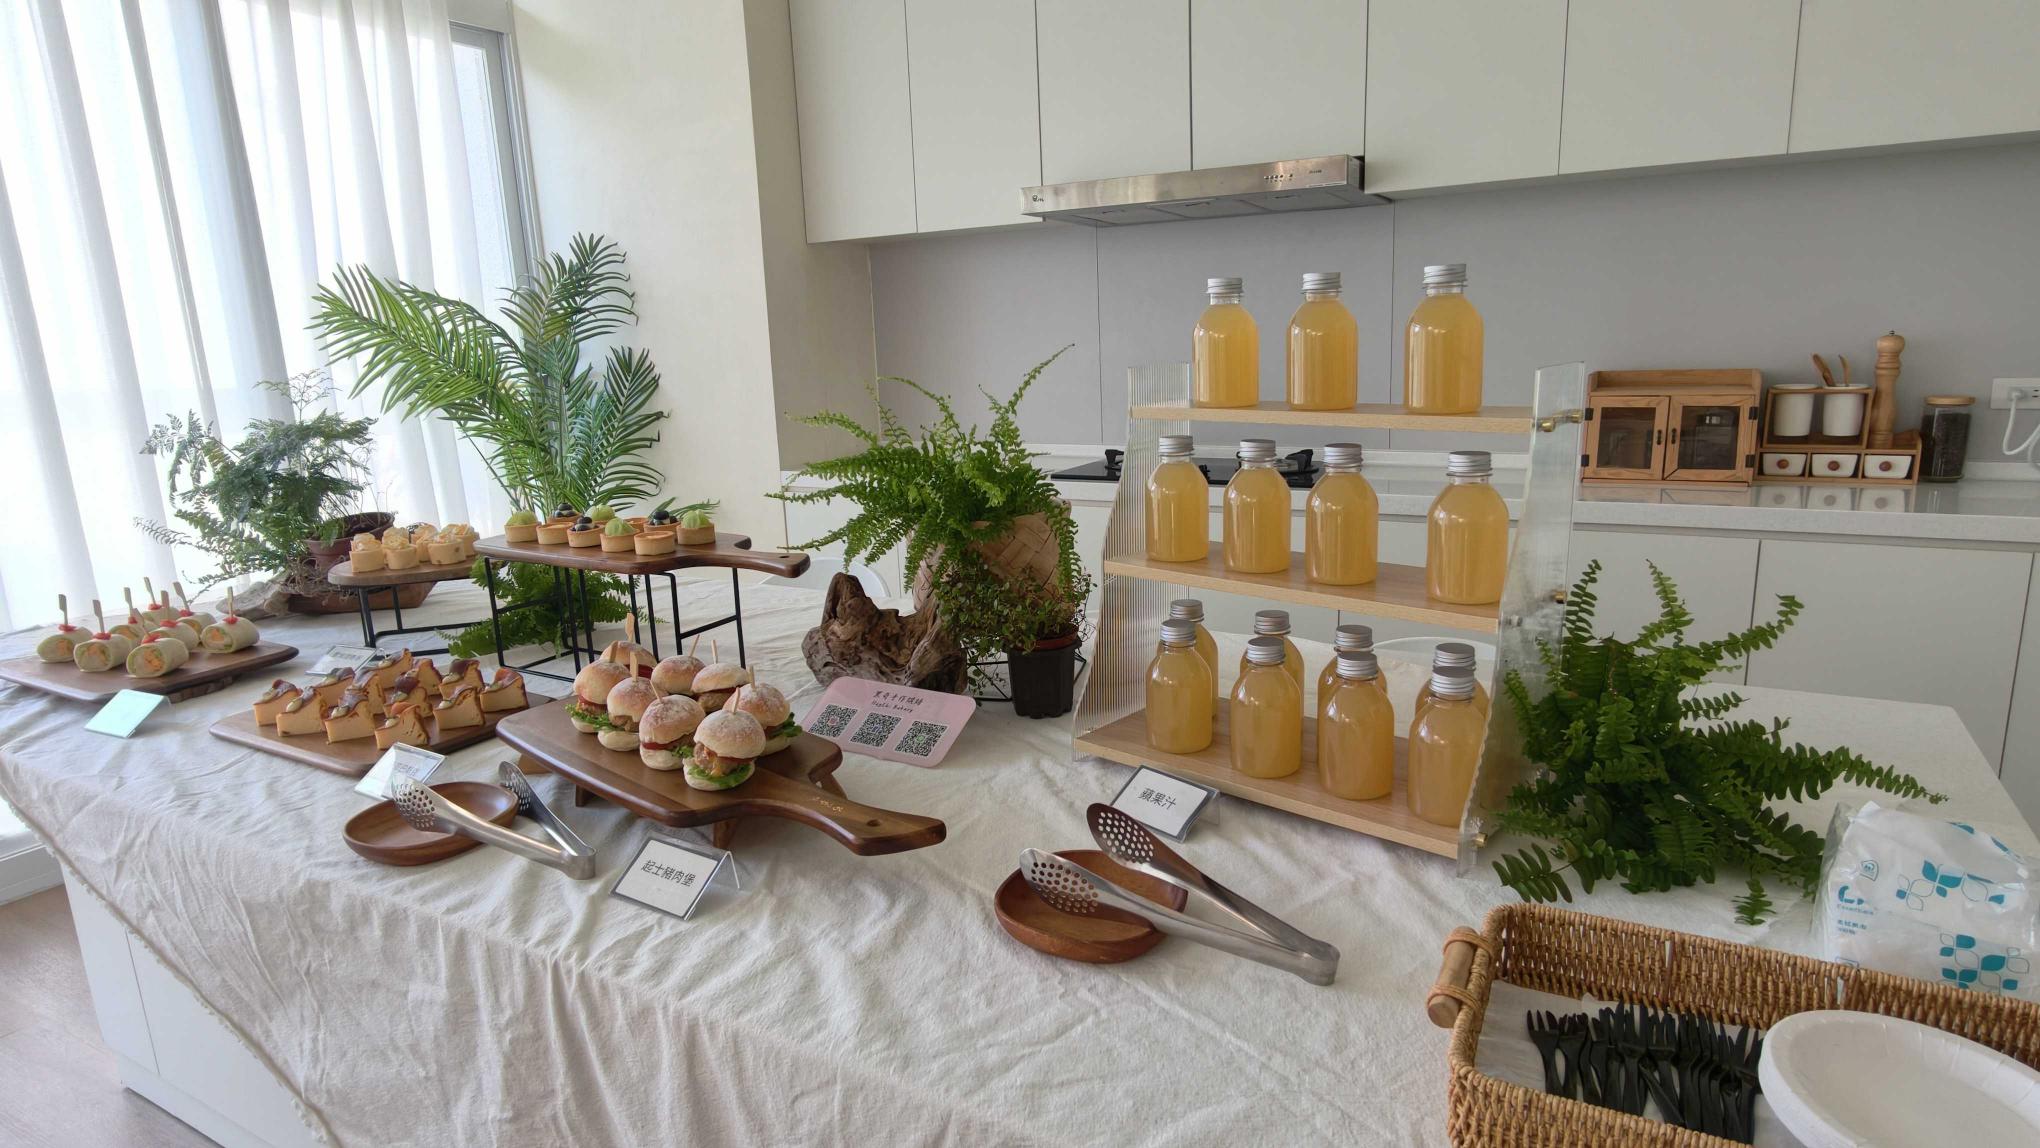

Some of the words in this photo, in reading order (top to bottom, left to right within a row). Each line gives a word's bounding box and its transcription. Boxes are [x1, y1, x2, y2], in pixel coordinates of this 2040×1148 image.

[1137, 788, 1177, 810] 蘋果汁
[641, 859, 697, 887] 起士豬肉堡
